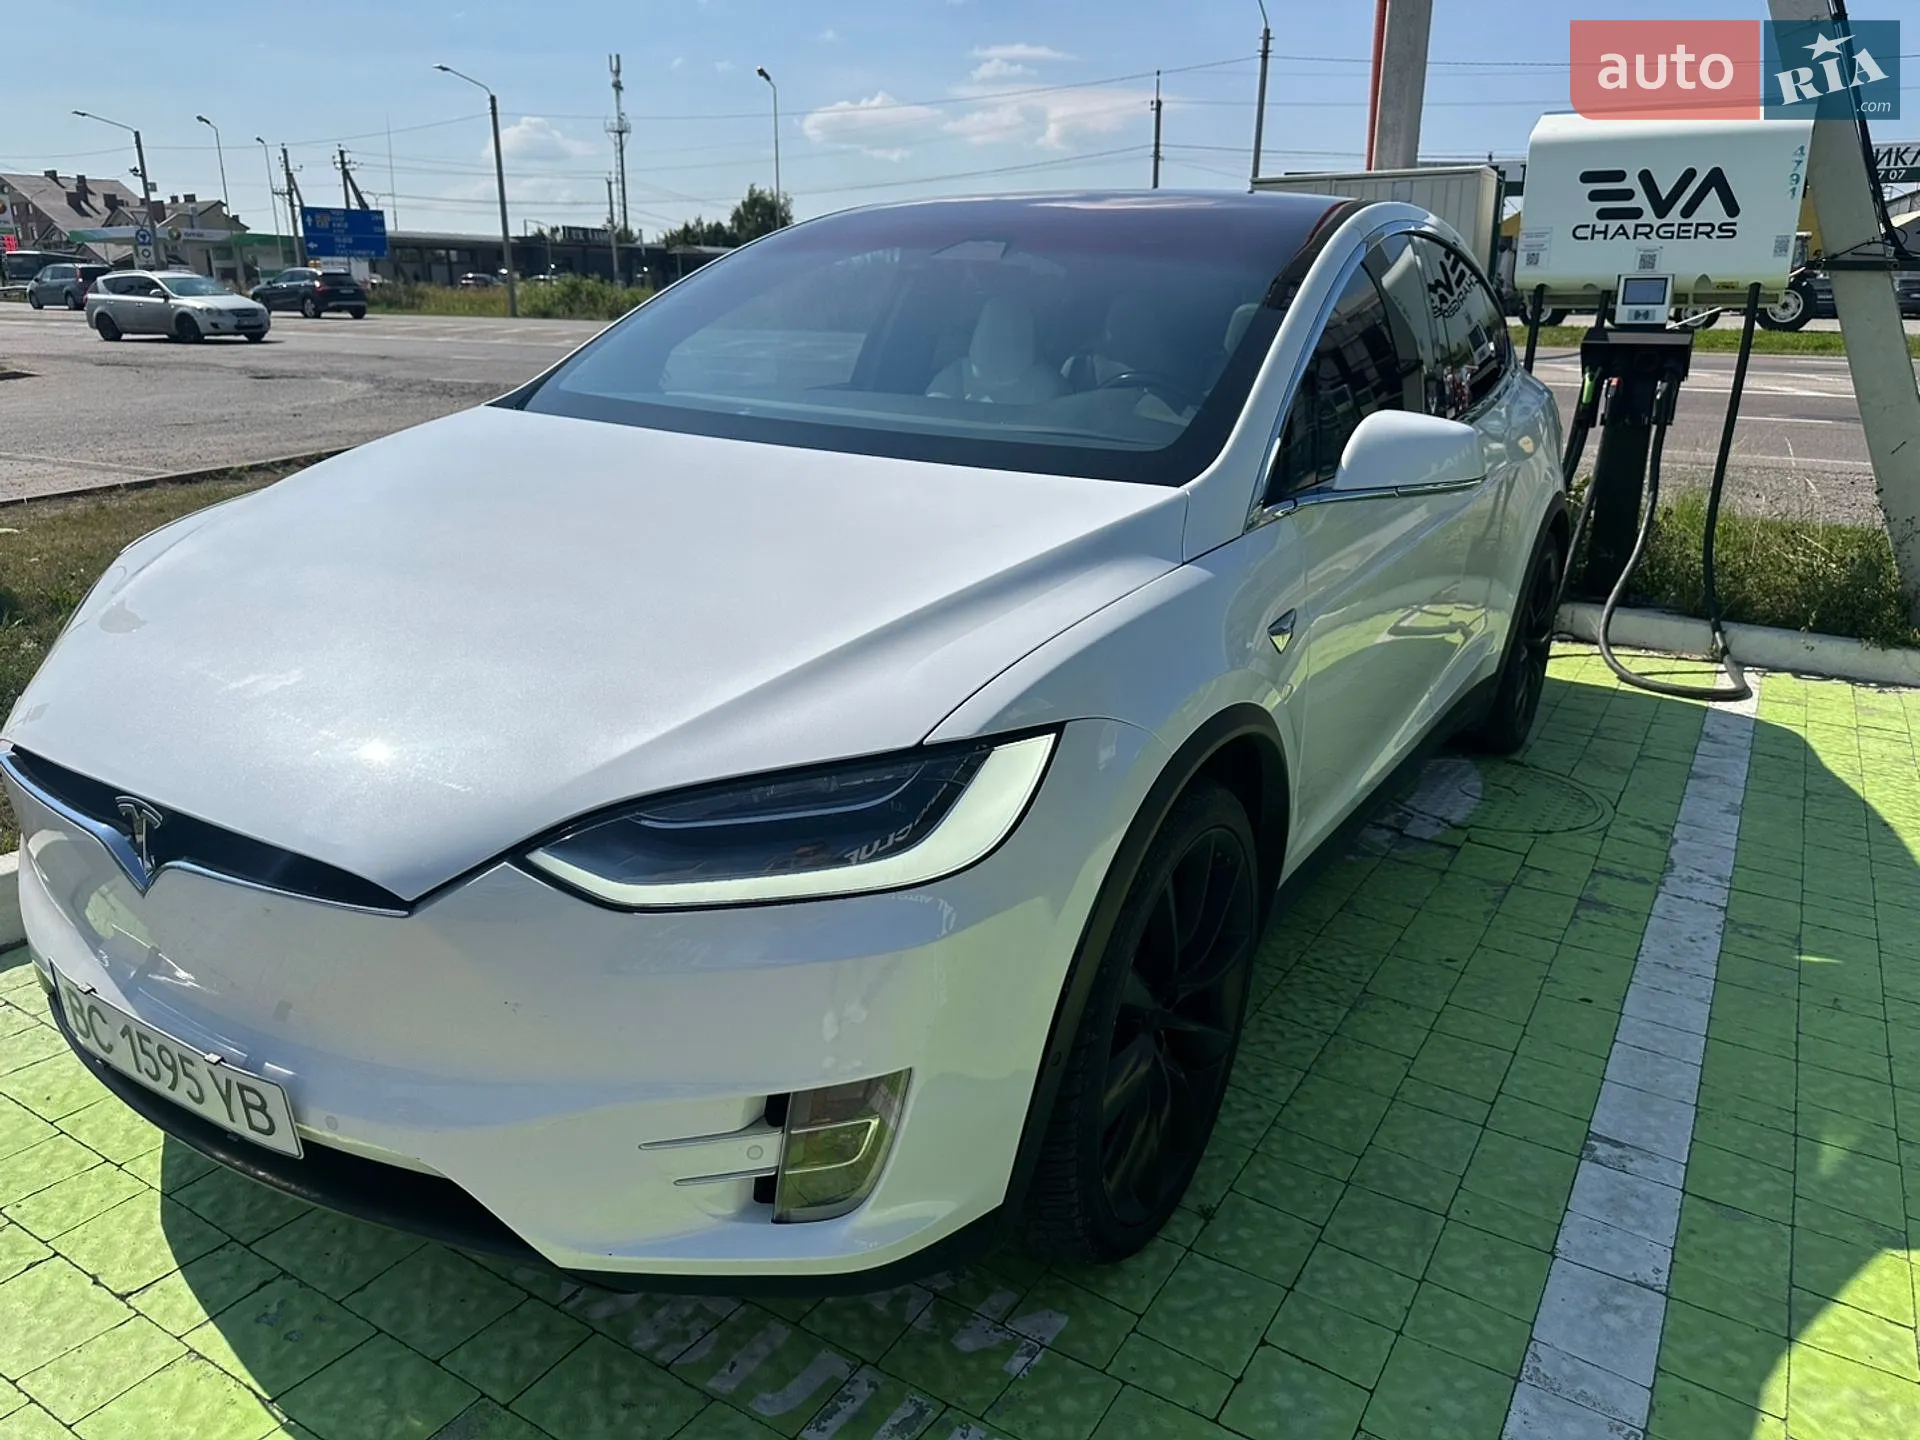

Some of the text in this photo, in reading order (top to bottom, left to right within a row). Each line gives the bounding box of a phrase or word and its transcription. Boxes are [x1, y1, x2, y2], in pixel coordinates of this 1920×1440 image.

[1579, 166, 1741, 220] EVA
[1889, 169, 1906, 180] 07
[1572, 221, 1738, 241] CHARGERS
[65, 985, 113, 1054] BC
[119, 1023, 205, 1105] 1595
